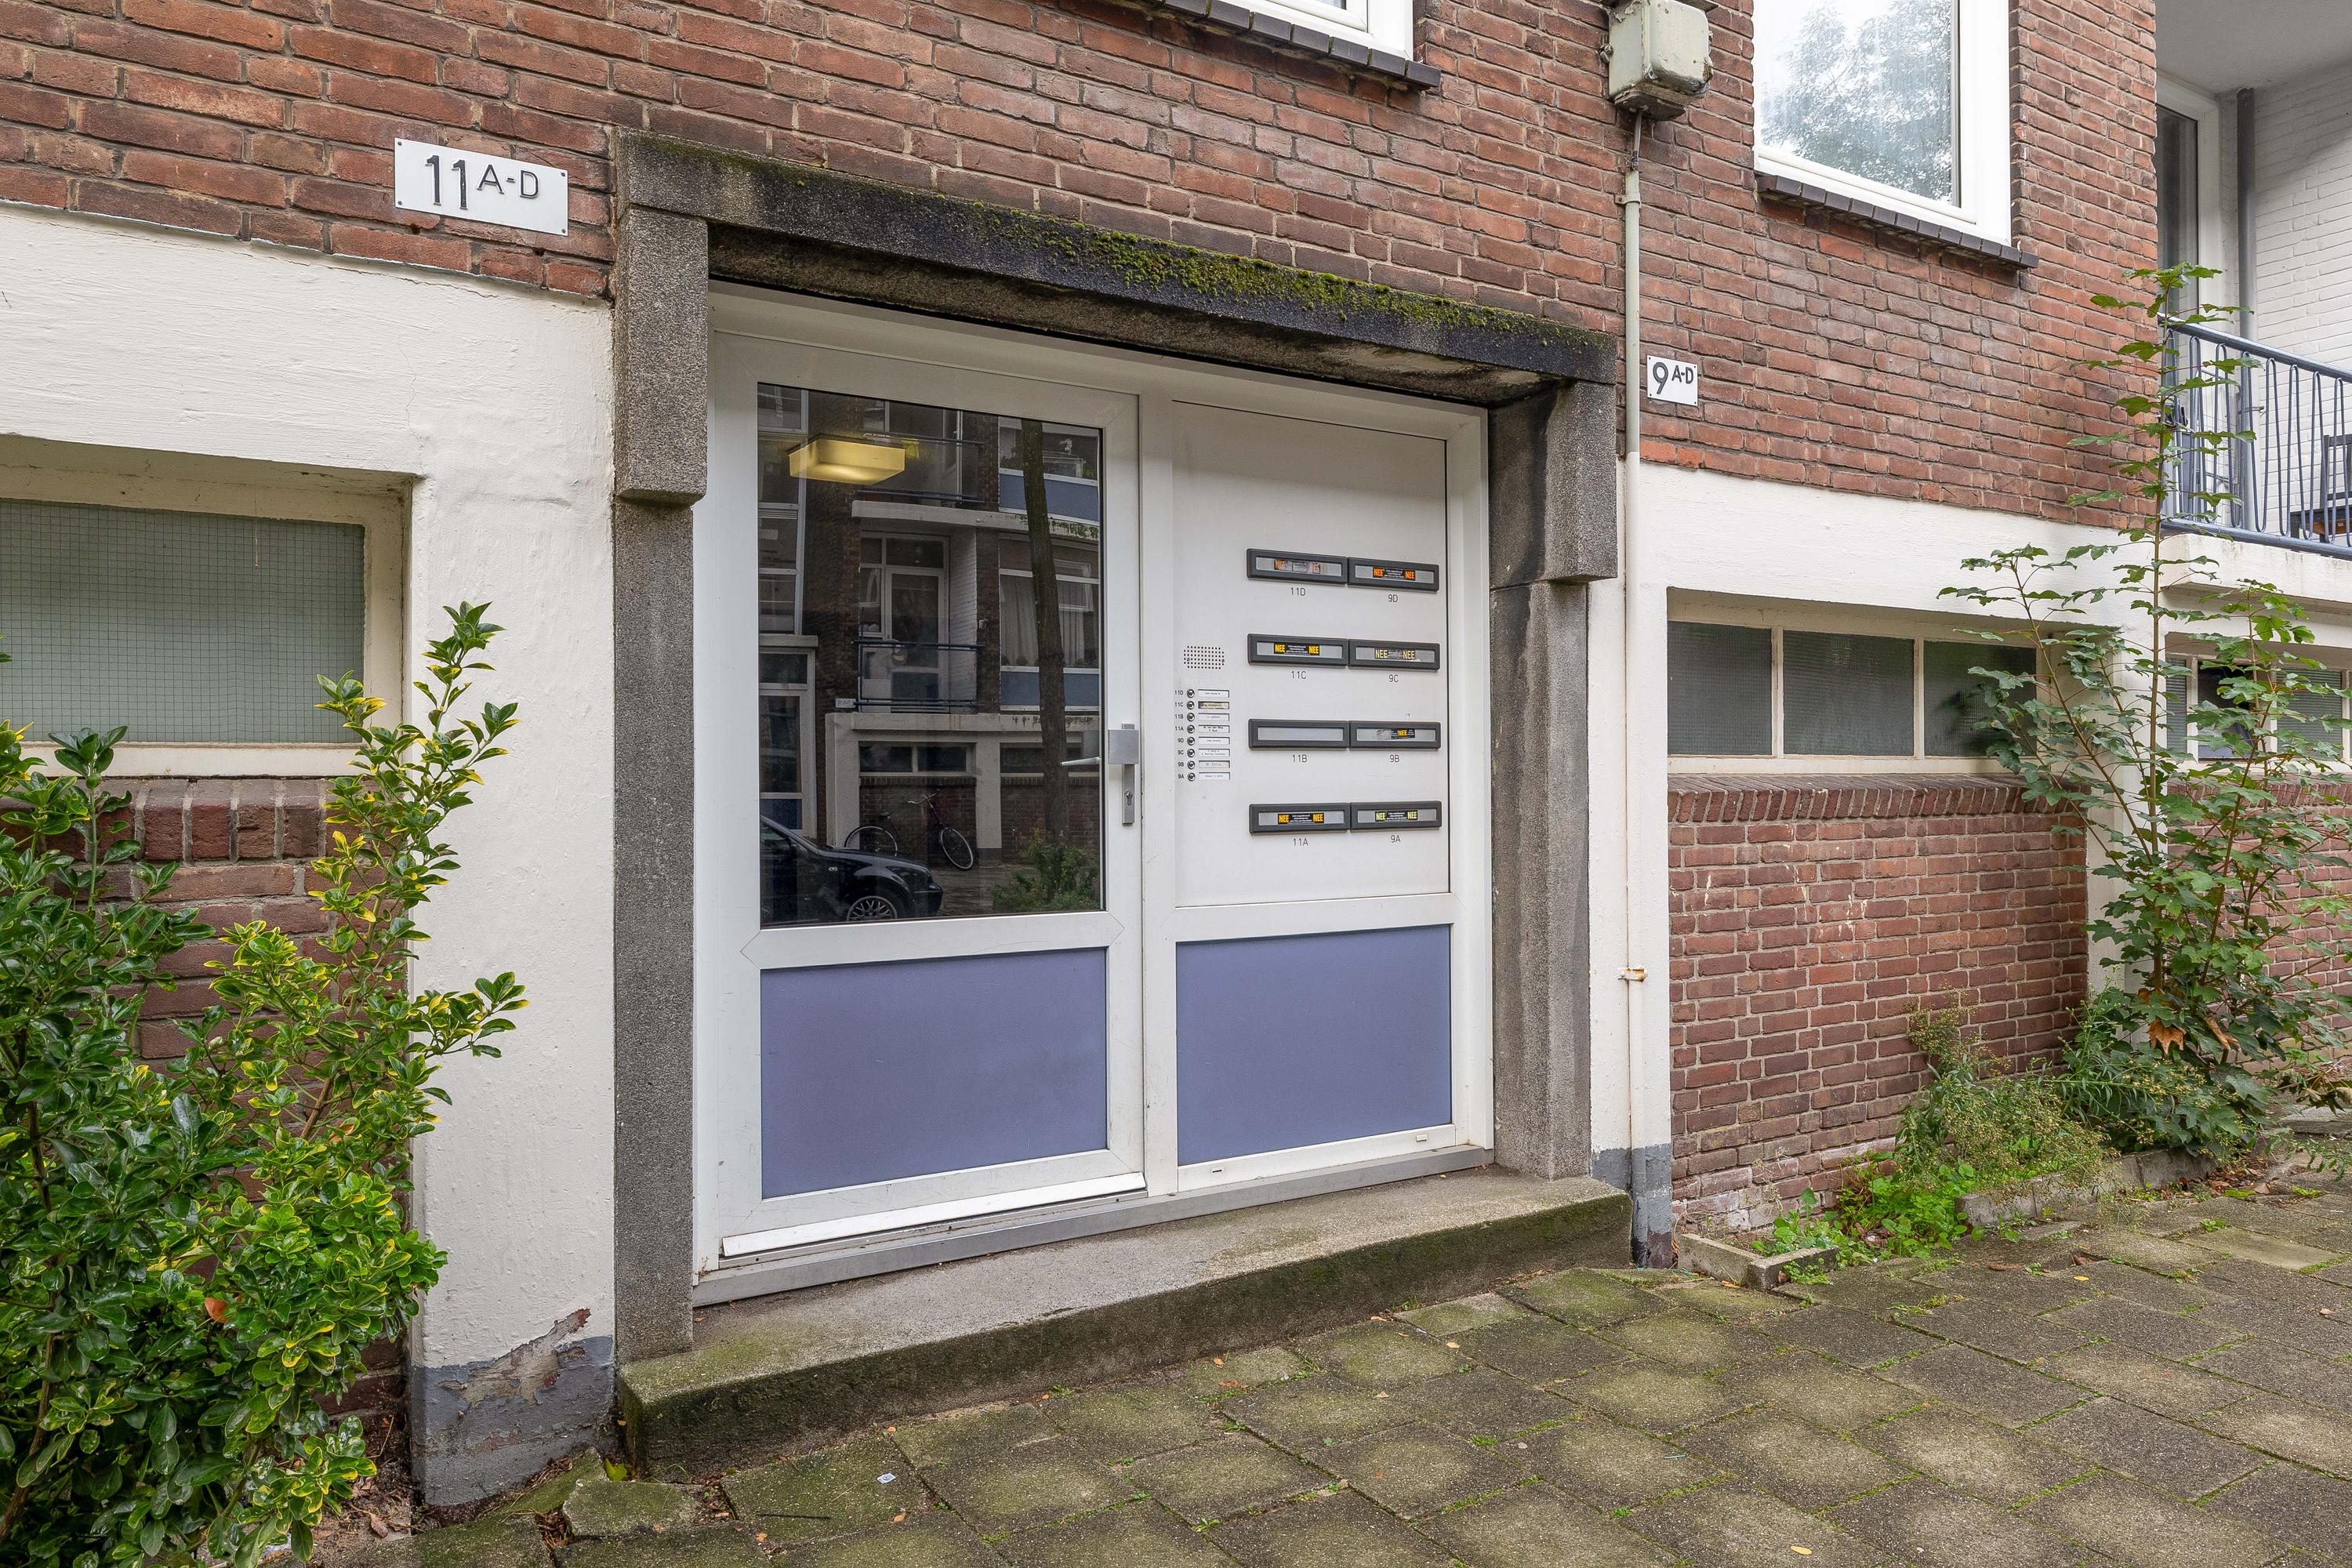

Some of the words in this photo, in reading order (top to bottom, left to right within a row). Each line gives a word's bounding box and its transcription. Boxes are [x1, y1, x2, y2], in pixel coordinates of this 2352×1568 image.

[1374, 568, 1384, 577] NEE
[1405, 571, 1414, 580] NEE
[1290, 586, 1306, 596] 11D
[1388, 593, 1399, 603] 9D
[1275, 644, 1286, 652] NEE
[1308, 645, 1319, 654] NEE
[1375, 649, 1388, 659] NEE
[1403, 650, 1415, 659] NEE
[1291, 670, 1307, 680] 11C
[1388, 673, 1399, 683] 9C
[1292, 754, 1308, 763] 11B
[1389, 754, 1400, 763] 9B
[1279, 815, 1290, 823] NEE
[1312, 814, 1323, 822] NEE
[1376, 812, 1386, 821] NEE
[1407, 811, 1417, 819] NEE
[1293, 838, 1308, 847] 11A
[1390, 834, 1401, 844] 9A
